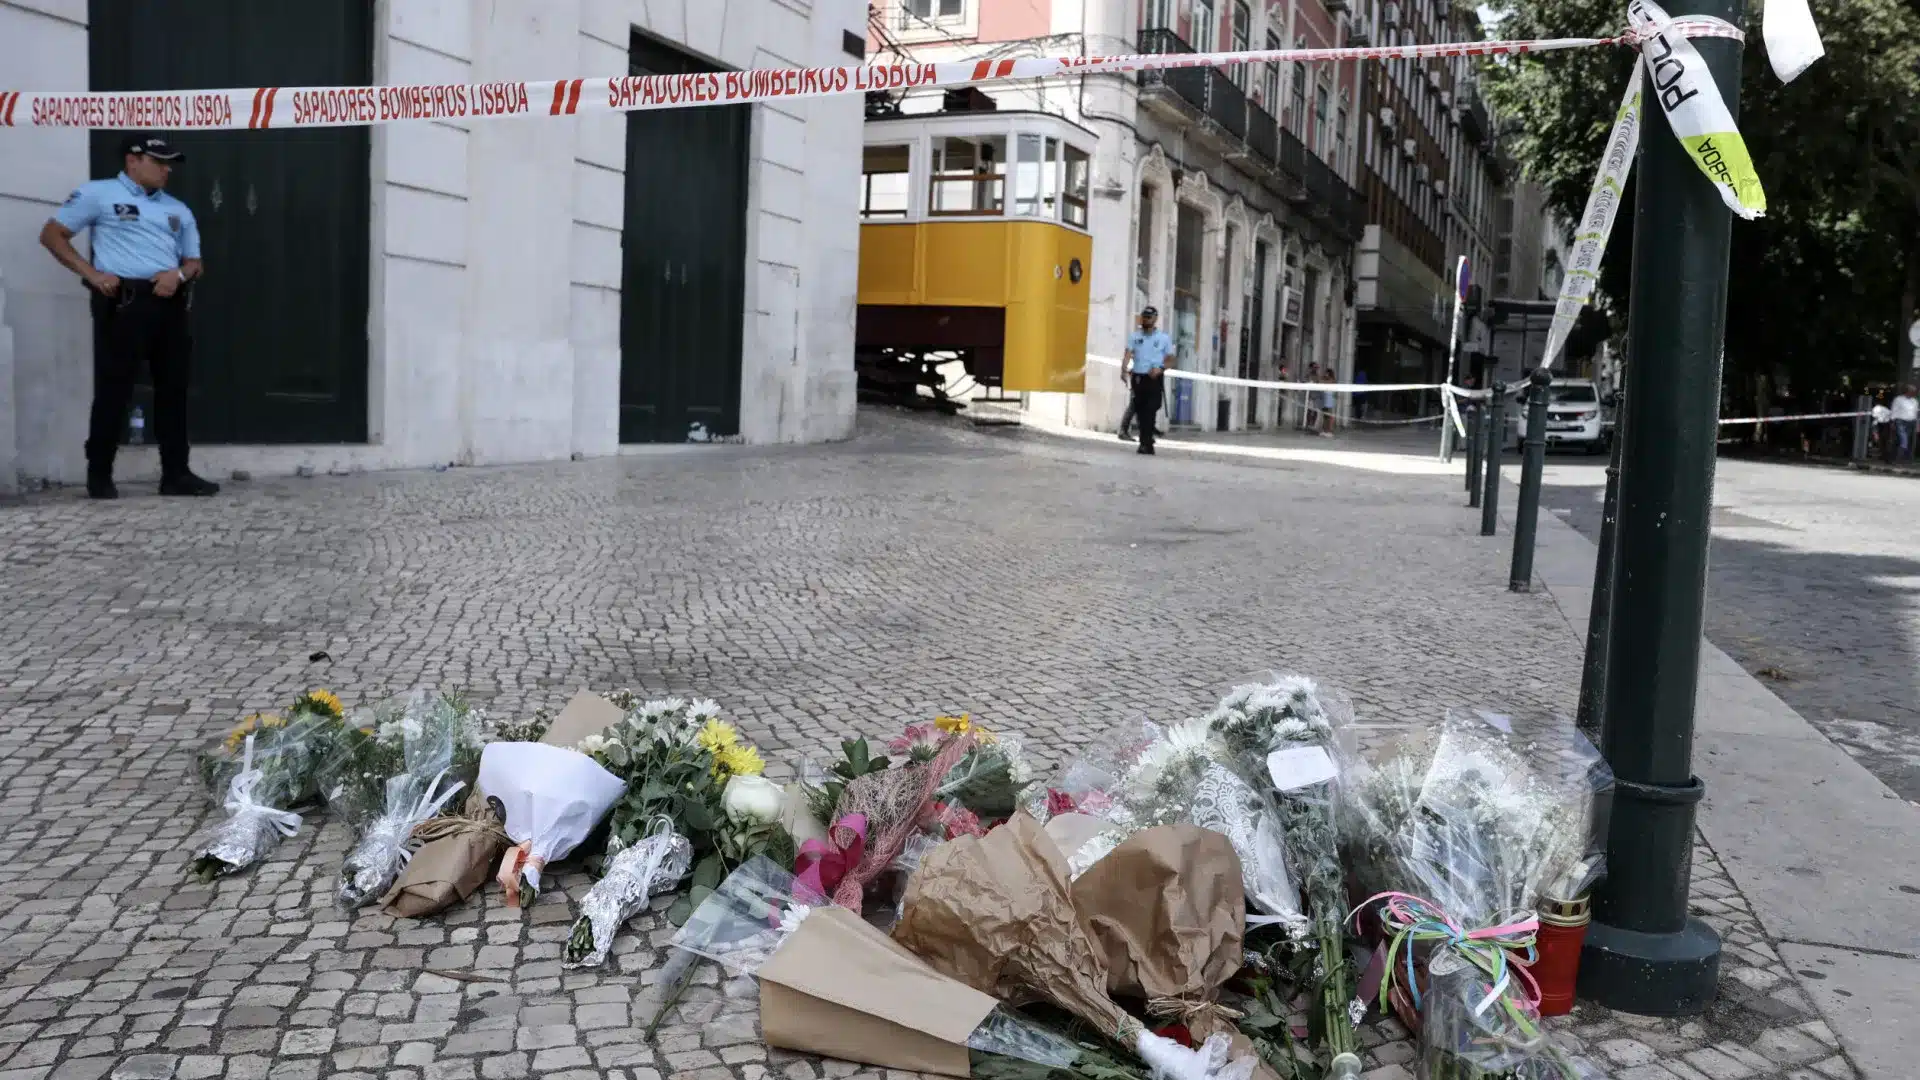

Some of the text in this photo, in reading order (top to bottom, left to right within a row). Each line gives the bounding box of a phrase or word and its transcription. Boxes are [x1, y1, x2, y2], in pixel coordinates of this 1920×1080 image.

[292, 82, 529, 124] SAPADORES BOMBEIROS LISBOA
[608, 63, 937, 108] SAPADORES BOMBEIROS LISBOA
[32, 94, 232, 127] SAPADORES BOMBEIROS LISBOA
